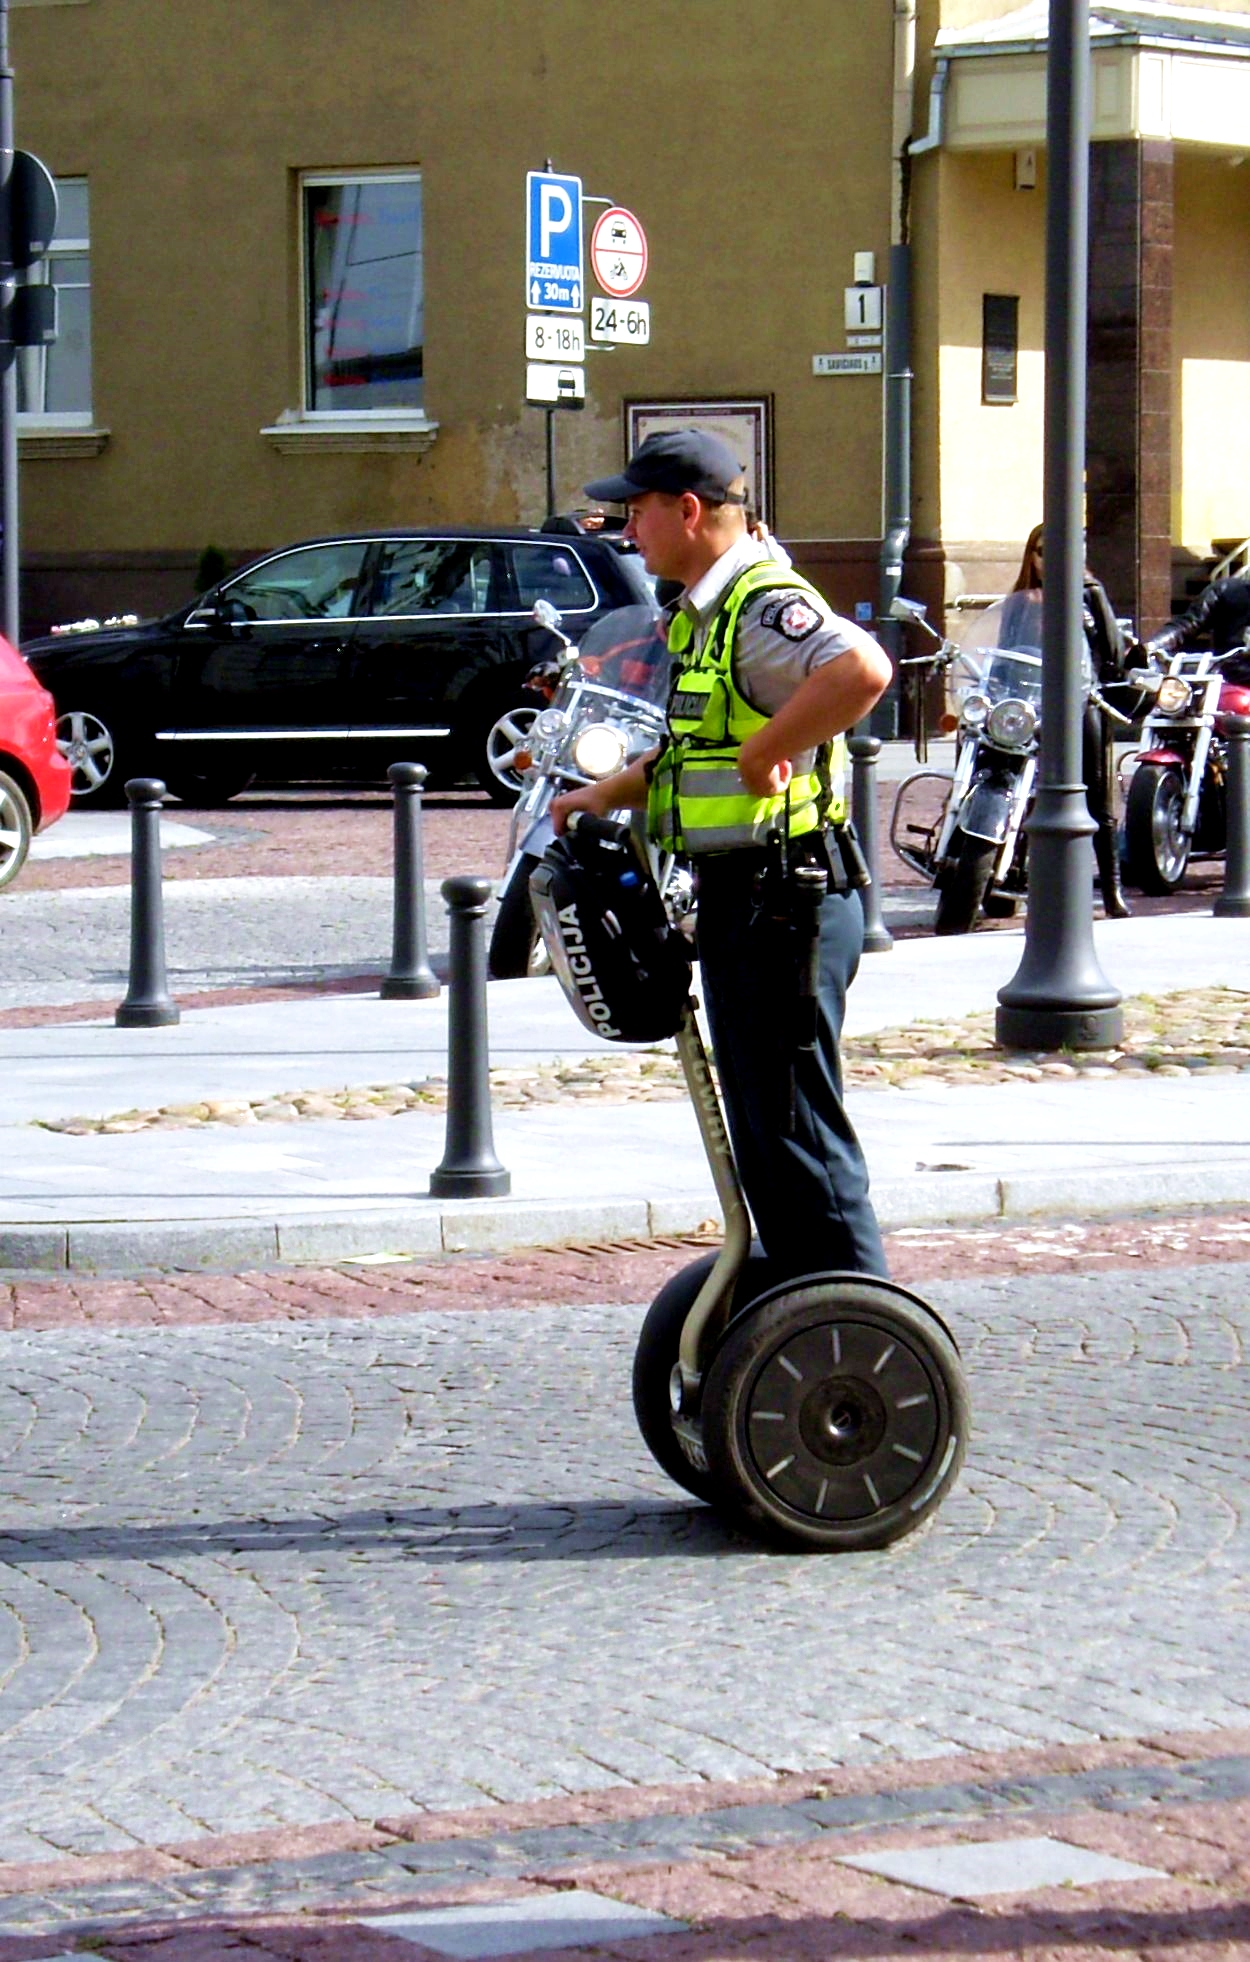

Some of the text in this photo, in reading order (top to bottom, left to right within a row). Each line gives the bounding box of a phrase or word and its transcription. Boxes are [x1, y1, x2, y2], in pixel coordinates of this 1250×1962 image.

[541, 184, 573, 258] P
[544, 282, 570, 301] 30m
[595, 308, 646, 336] 24-6h
[858, 294, 865, 323] 1
[558, 903, 622, 1038] POLICIJA
